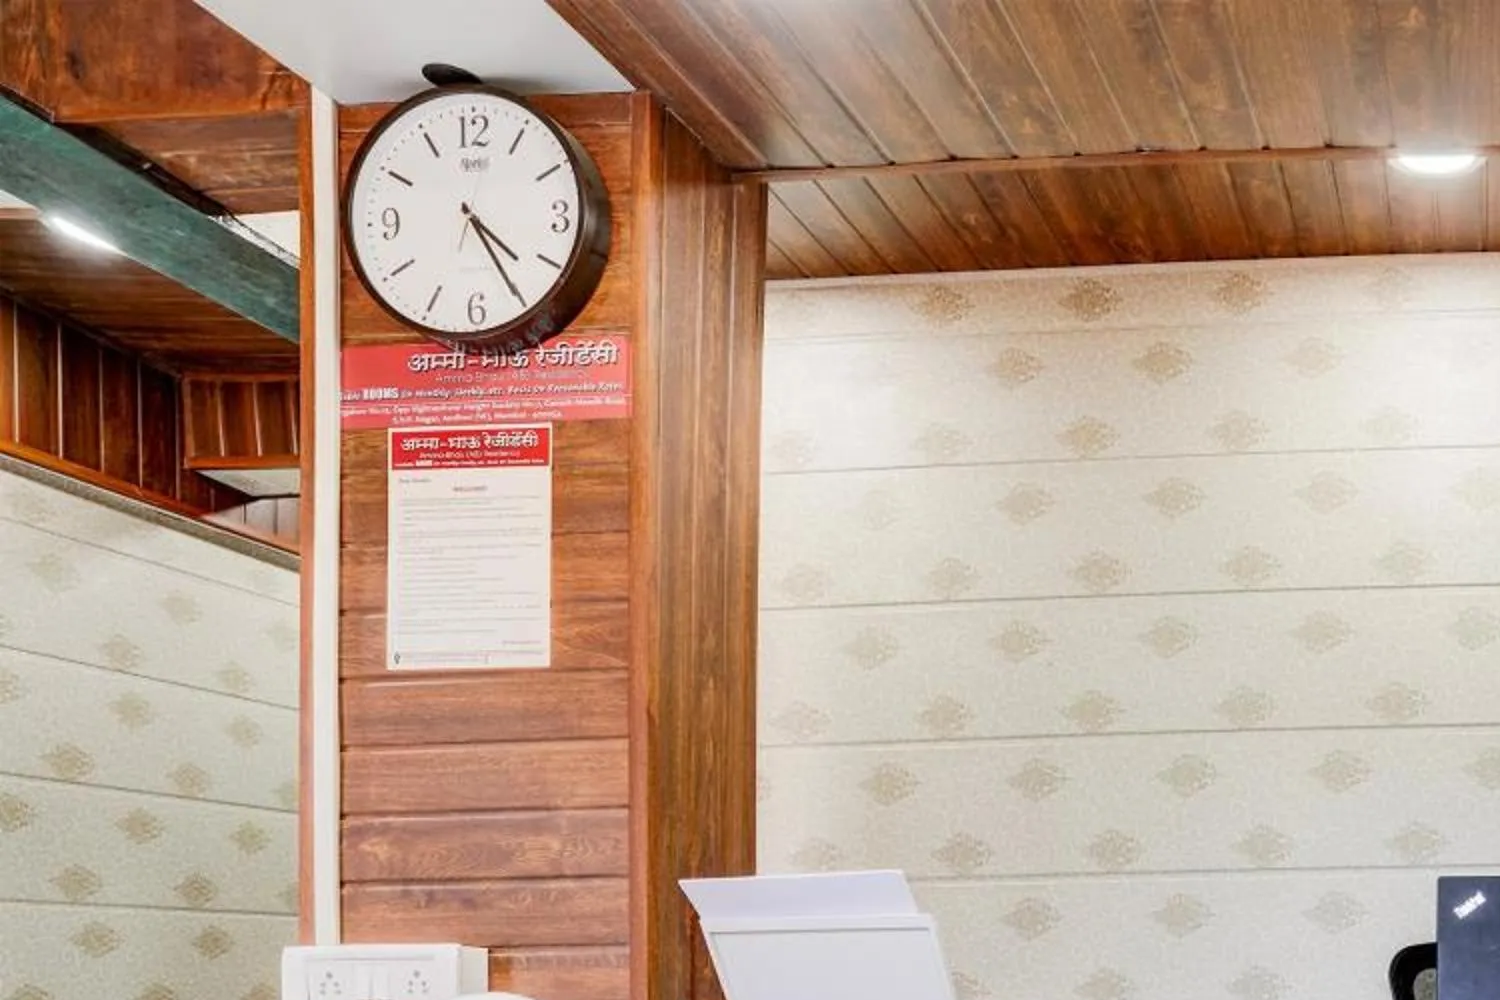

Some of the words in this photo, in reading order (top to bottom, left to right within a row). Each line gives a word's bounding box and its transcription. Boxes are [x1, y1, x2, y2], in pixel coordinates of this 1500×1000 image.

[458, 115, 490, 149] 12
[381, 207, 401, 241] 9
[550, 199, 570, 234] 3
[467, 291, 487, 325] 6
